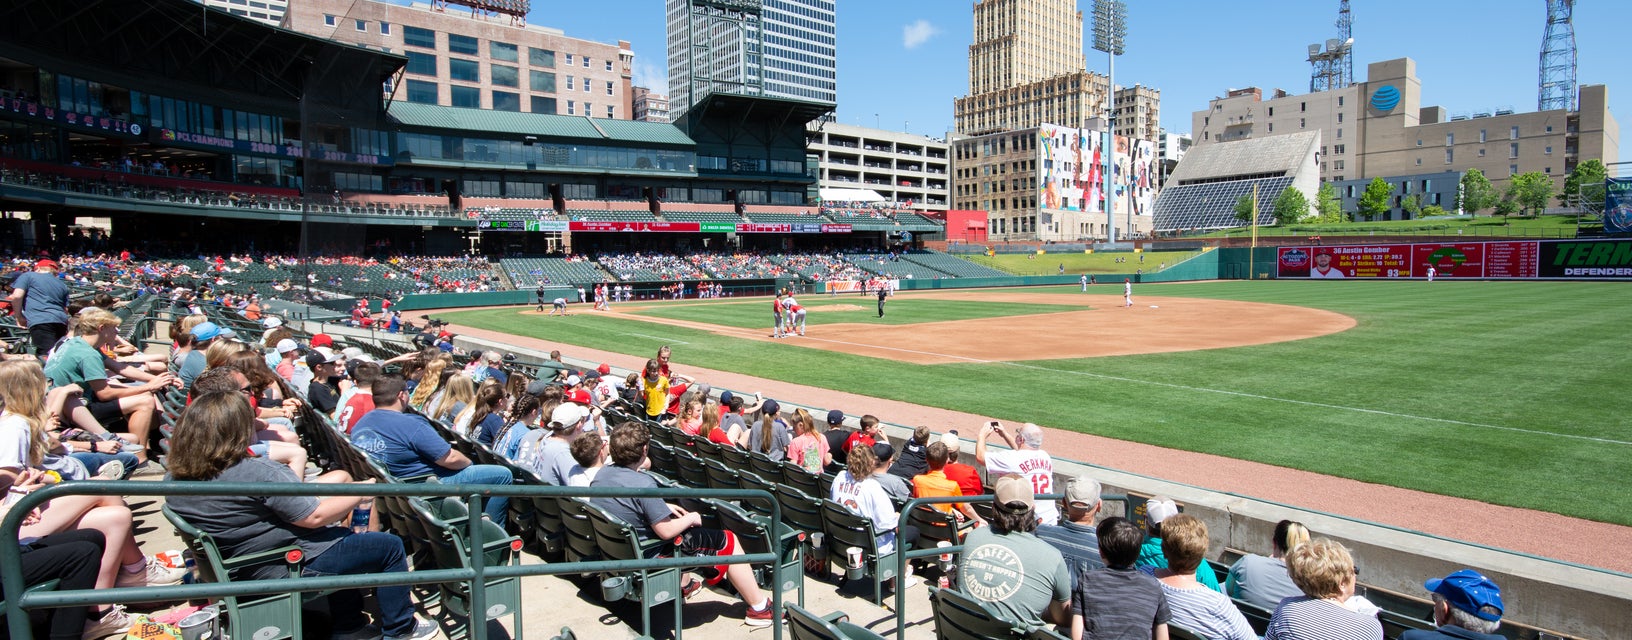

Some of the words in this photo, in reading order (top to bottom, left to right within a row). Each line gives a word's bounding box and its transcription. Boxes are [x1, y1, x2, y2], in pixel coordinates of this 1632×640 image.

[177, 132, 190, 141] PCL
[192, 134, 234, 148] CHAMPIONS
[324, 152, 346, 161] 2017
[1019, 459, 1052, 474] BERKMAN
[839, 482, 861, 496] WONG
[1031, 473, 1049, 494] 12
[977, 548, 1017, 565] SAFETY
[984, 572, 994, 581] BY
[967, 574, 1012, 598] ACCIDENT
